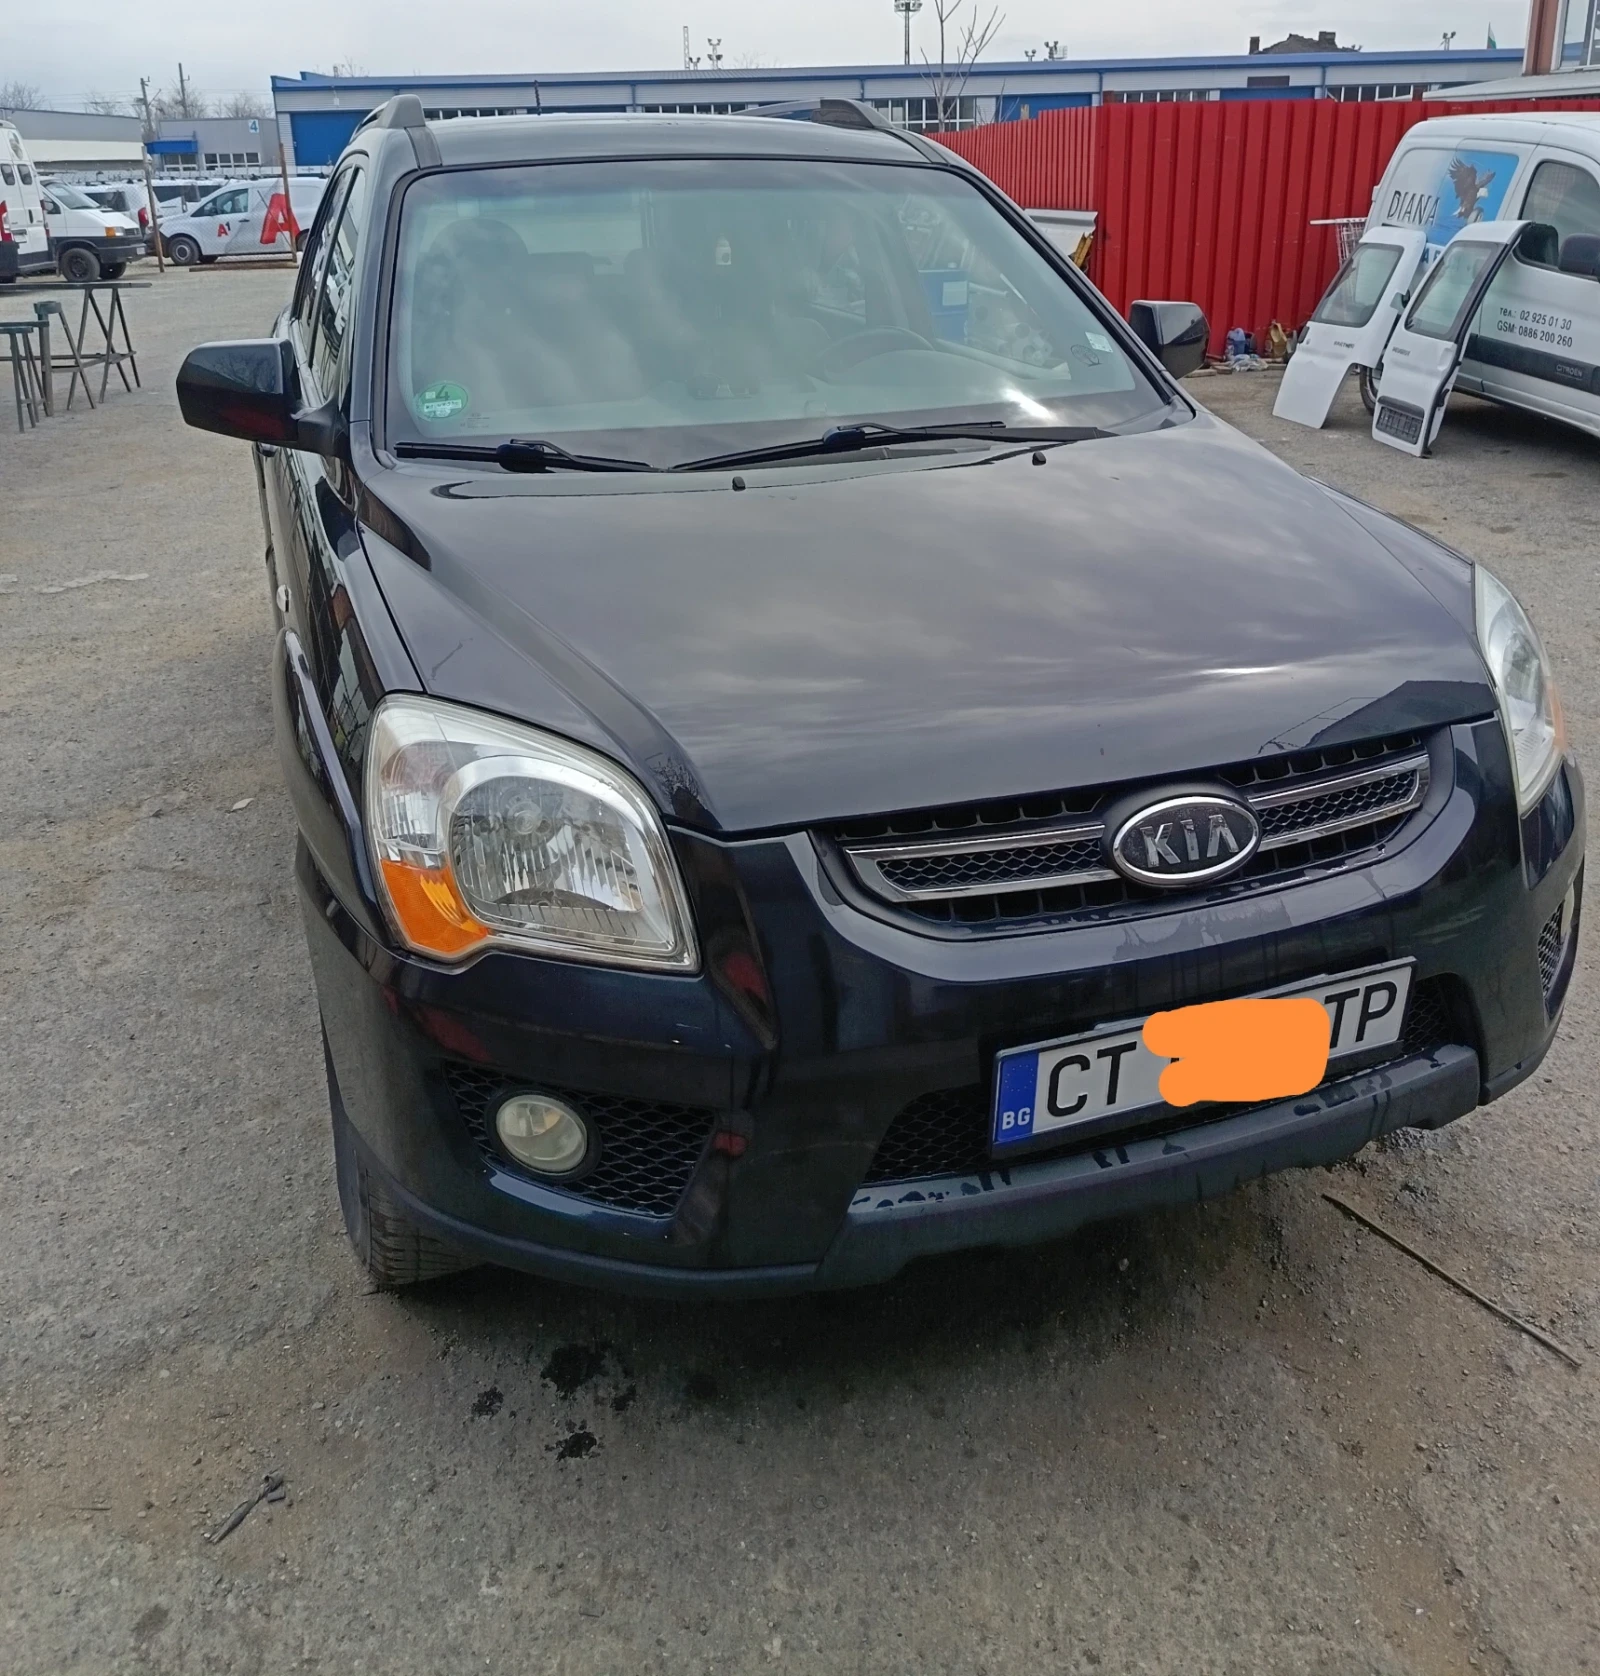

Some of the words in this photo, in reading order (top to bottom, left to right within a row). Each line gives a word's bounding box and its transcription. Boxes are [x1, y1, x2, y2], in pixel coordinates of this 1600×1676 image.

[250, 120, 258, 132] 4
[1386, 190, 1440, 227] DIANA
[217, 221, 231, 237] A1
[1520, 310, 1530, 321] 02
[1531, 312, 1547, 325] 925
[1548, 316, 1559, 328] 01
[1560, 319, 1572, 331] 30
[1497, 320, 1517, 334] GSM:
[1518, 325, 1538, 340] 0886
[1539, 330, 1556, 344] 200
[1557, 334, 1573, 348] 260
[1139, 814, 1240, 868] KIA
[1046, 1041, 1137, 1118] CT
[1324, 980, 1398, 1049] TP
[1001, 1107, 1031, 1130] BG
